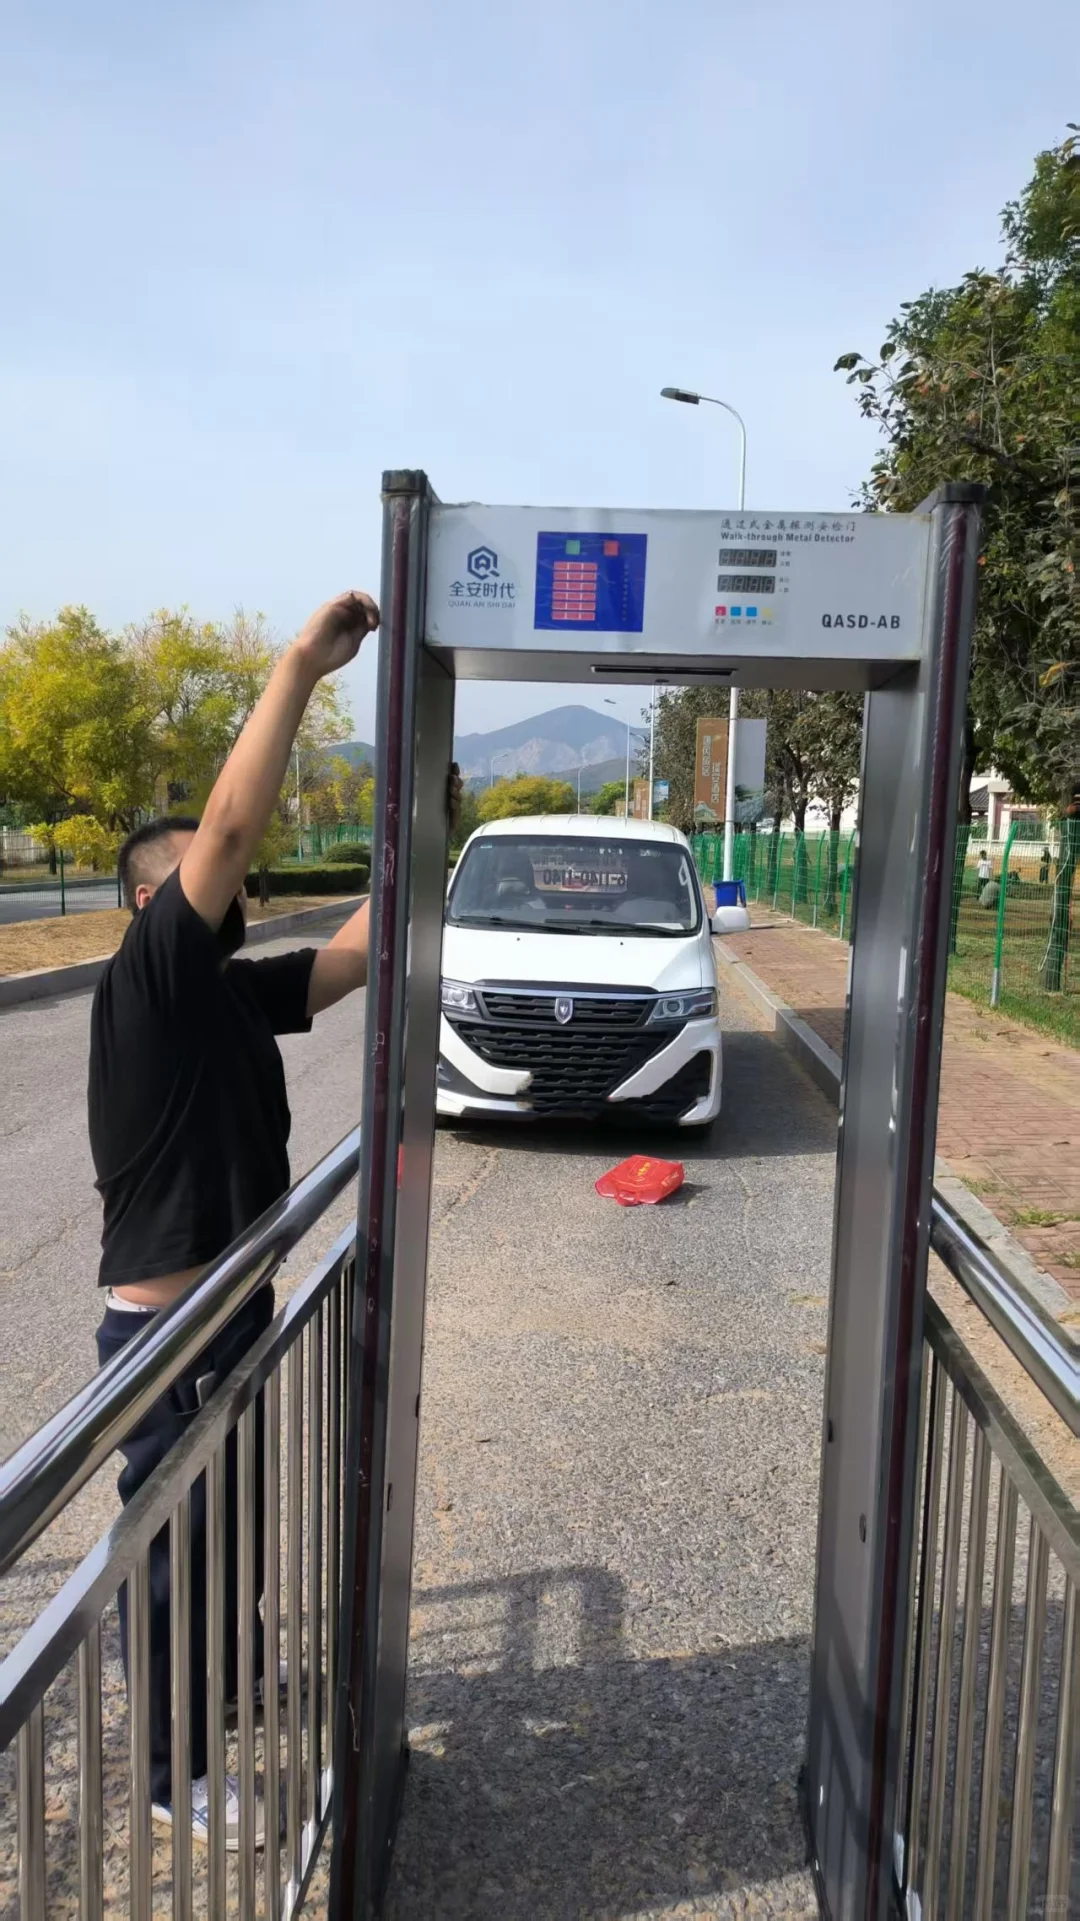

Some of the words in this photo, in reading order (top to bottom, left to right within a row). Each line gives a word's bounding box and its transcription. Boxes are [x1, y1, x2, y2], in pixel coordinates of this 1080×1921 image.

[720, 518, 856, 532] 通过式金属探测安检门
[720, 532, 784, 542] Walk-through
[785, 533, 812, 542] Metal
[814, 533, 855, 543] Detector
[449, 581, 515, 599] 全安时代
[448, 600, 471, 608] QUAN
[473, 600, 485, 608] AN
[502, 601, 515, 609] DAI
[821, 614, 900, 629] QASD-AB
